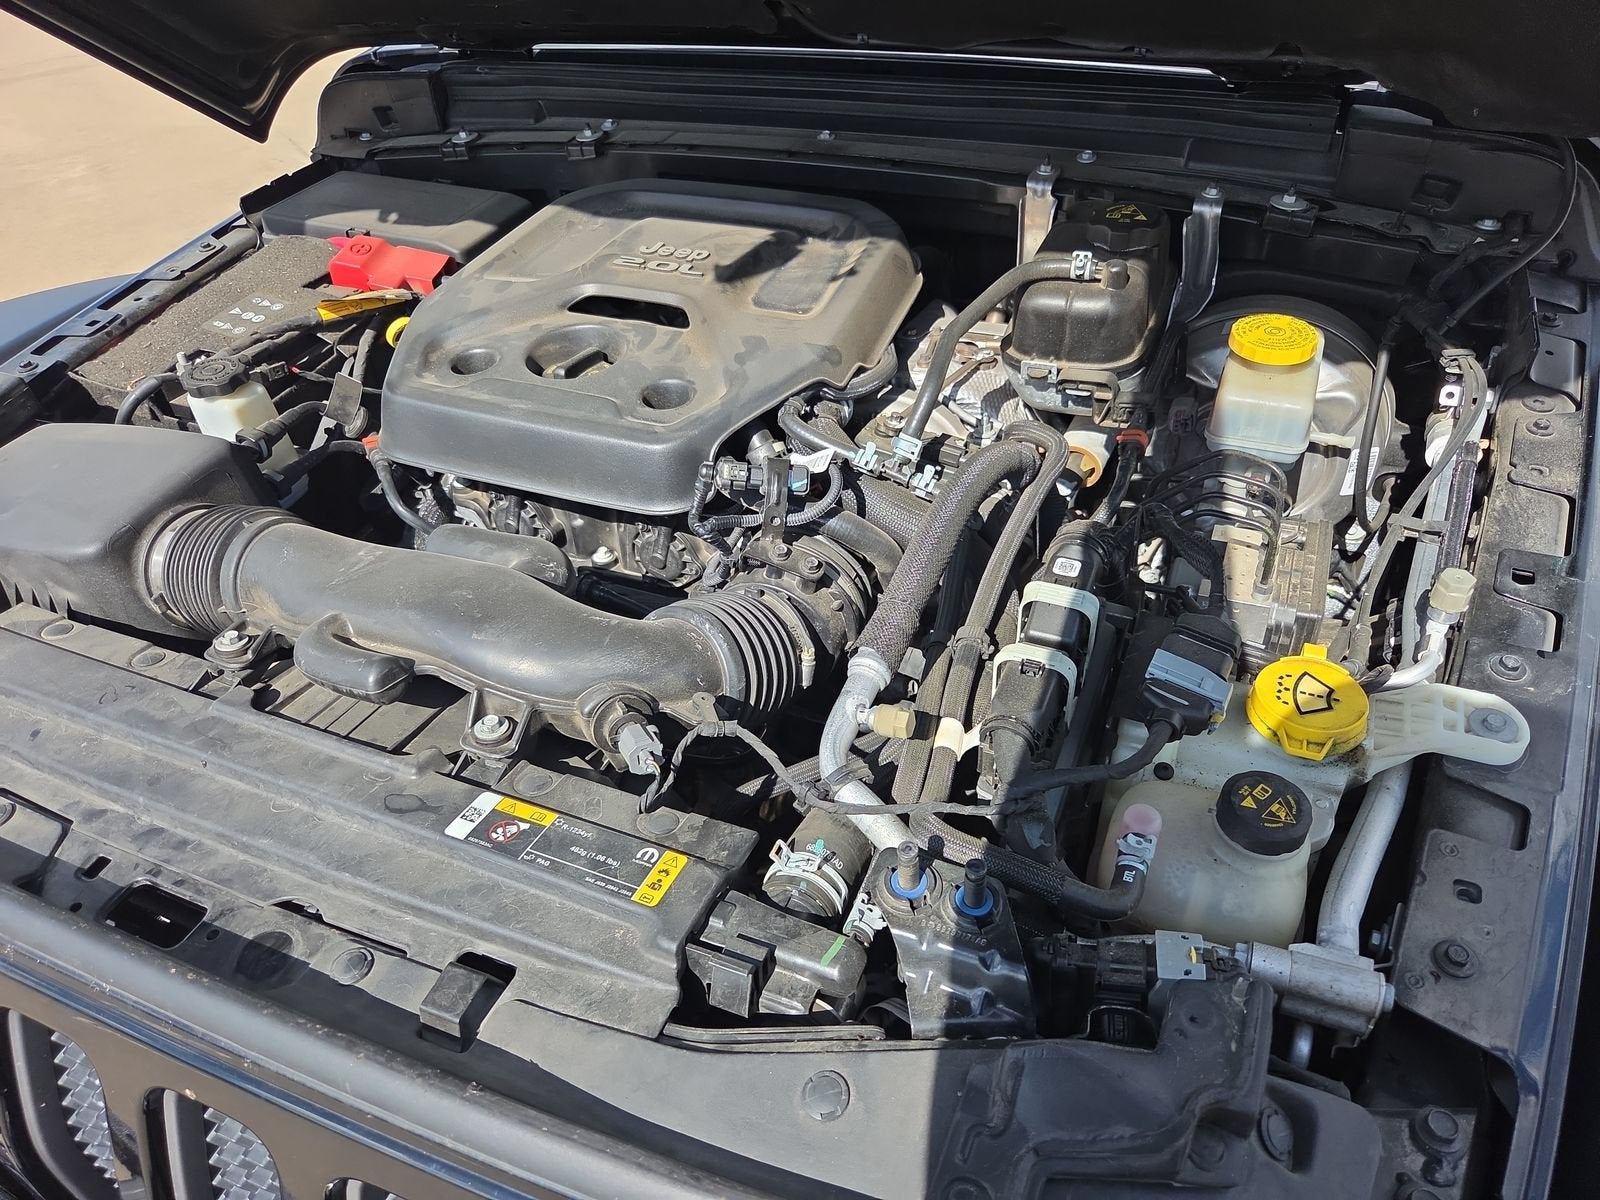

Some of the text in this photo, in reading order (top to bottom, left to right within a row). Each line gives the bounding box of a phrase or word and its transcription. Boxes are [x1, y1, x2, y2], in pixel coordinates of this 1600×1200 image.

[639, 241, 711, 262] Jeep
[612, 255, 704, 277] 2.0L
[561, 823, 592, 838] R-1234yf
[1123, 870, 1136, 883] BTL
